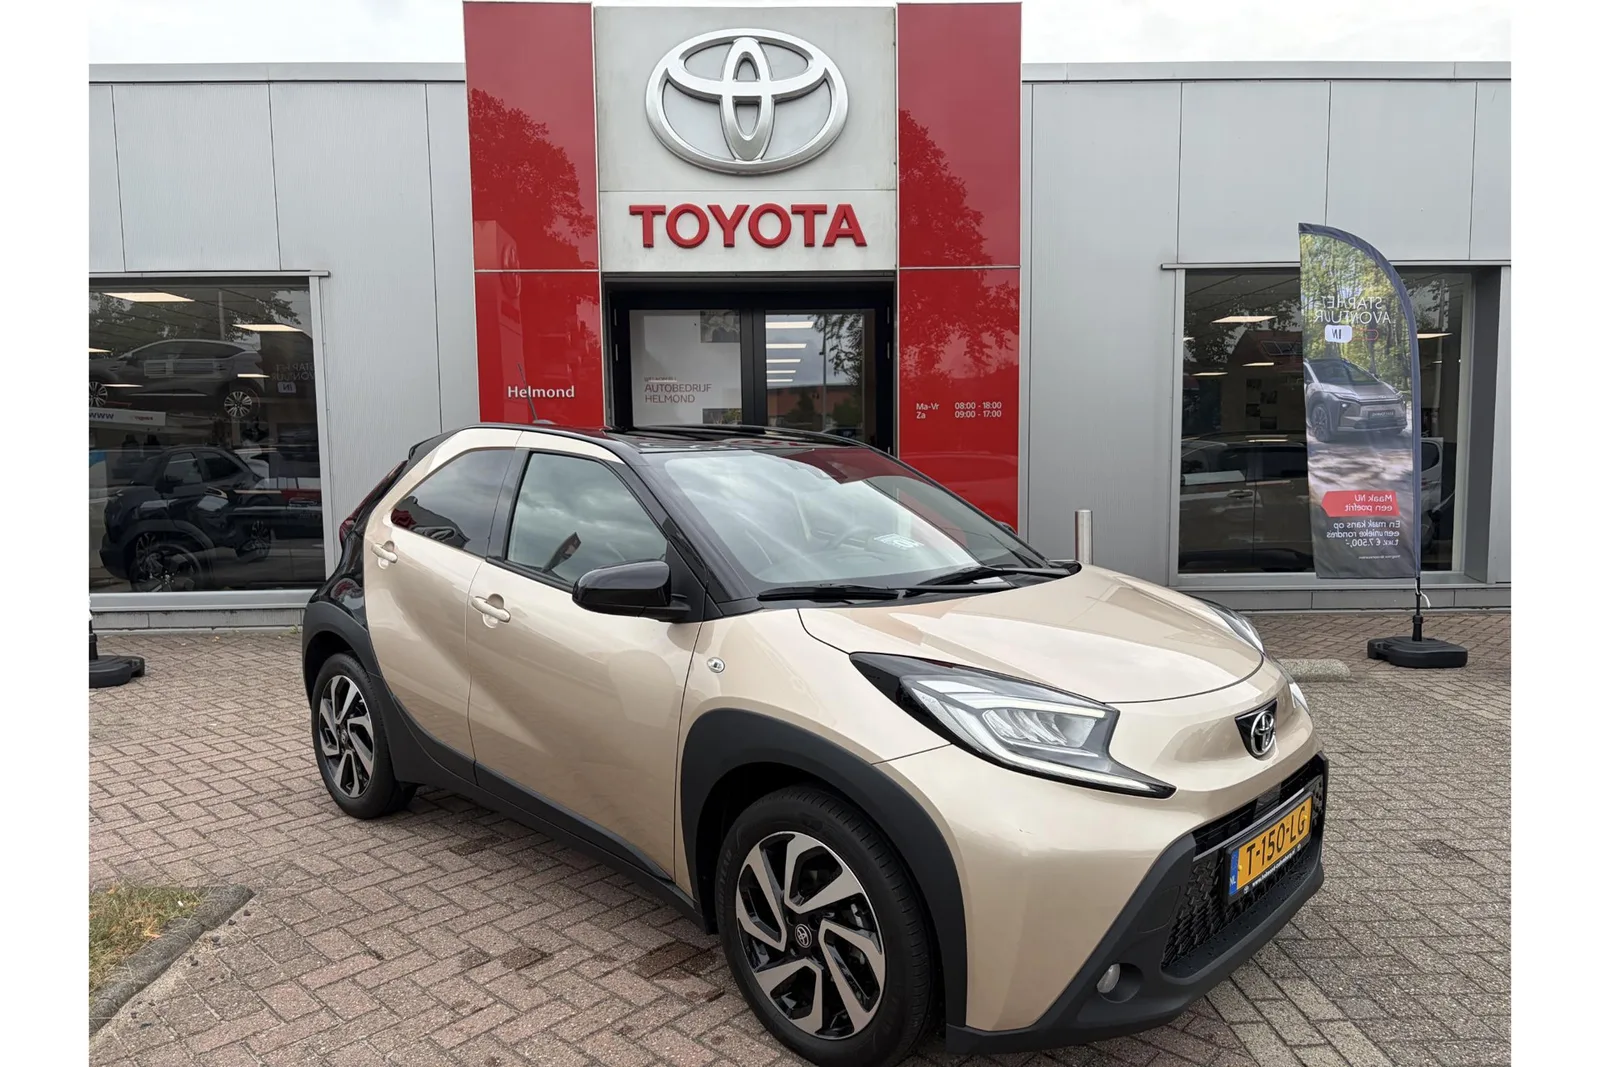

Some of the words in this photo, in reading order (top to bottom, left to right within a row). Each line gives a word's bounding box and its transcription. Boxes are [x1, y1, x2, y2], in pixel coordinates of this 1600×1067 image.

[629, 203, 867, 249] TOYOTA
[507, 385, 575, 398] Helmond
[644, 383, 712, 393] AUTOBEDRIJF
[645, 394, 695, 403] HELMOND
[916, 402, 939, 410] Ma-Vr
[982, 401, 1002, 409] 18:00
[916, 411, 926, 419] Za
[954, 410, 975, 418] 09:00
[983, 410, 1002, 418] 17:00
[1246, 805, 1306, 876] T-150-LG
